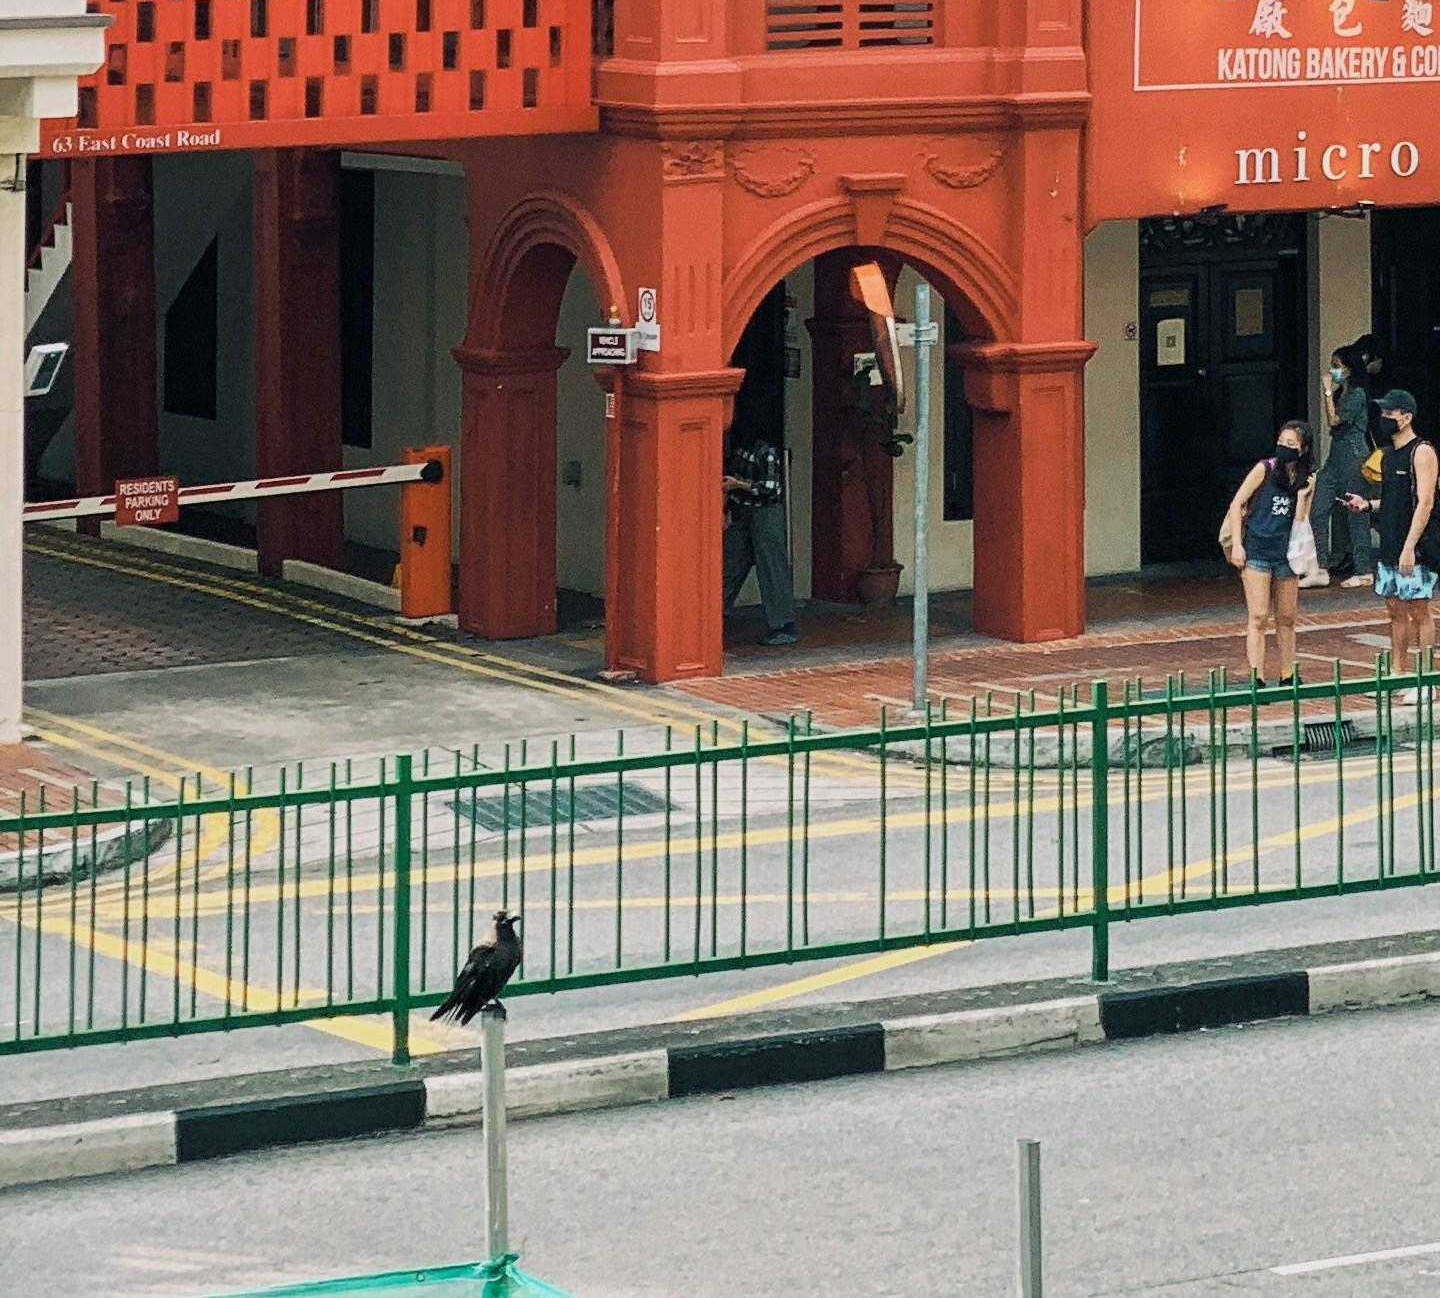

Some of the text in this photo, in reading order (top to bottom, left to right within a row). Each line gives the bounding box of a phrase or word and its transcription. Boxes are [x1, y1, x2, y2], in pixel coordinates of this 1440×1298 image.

[1217, 47, 1301, 81] KATONG
[1305, 45, 1390, 79] BAKERY
[1392, 45, 1405, 77] &
[52, 129, 221, 153] 63 East Coast Road
[1233, 130, 1420, 186] micro
[119, 480, 175, 496] RESIDENTS
[125, 494, 169, 509] PARKING
[135, 508, 162, 522] ONLY
